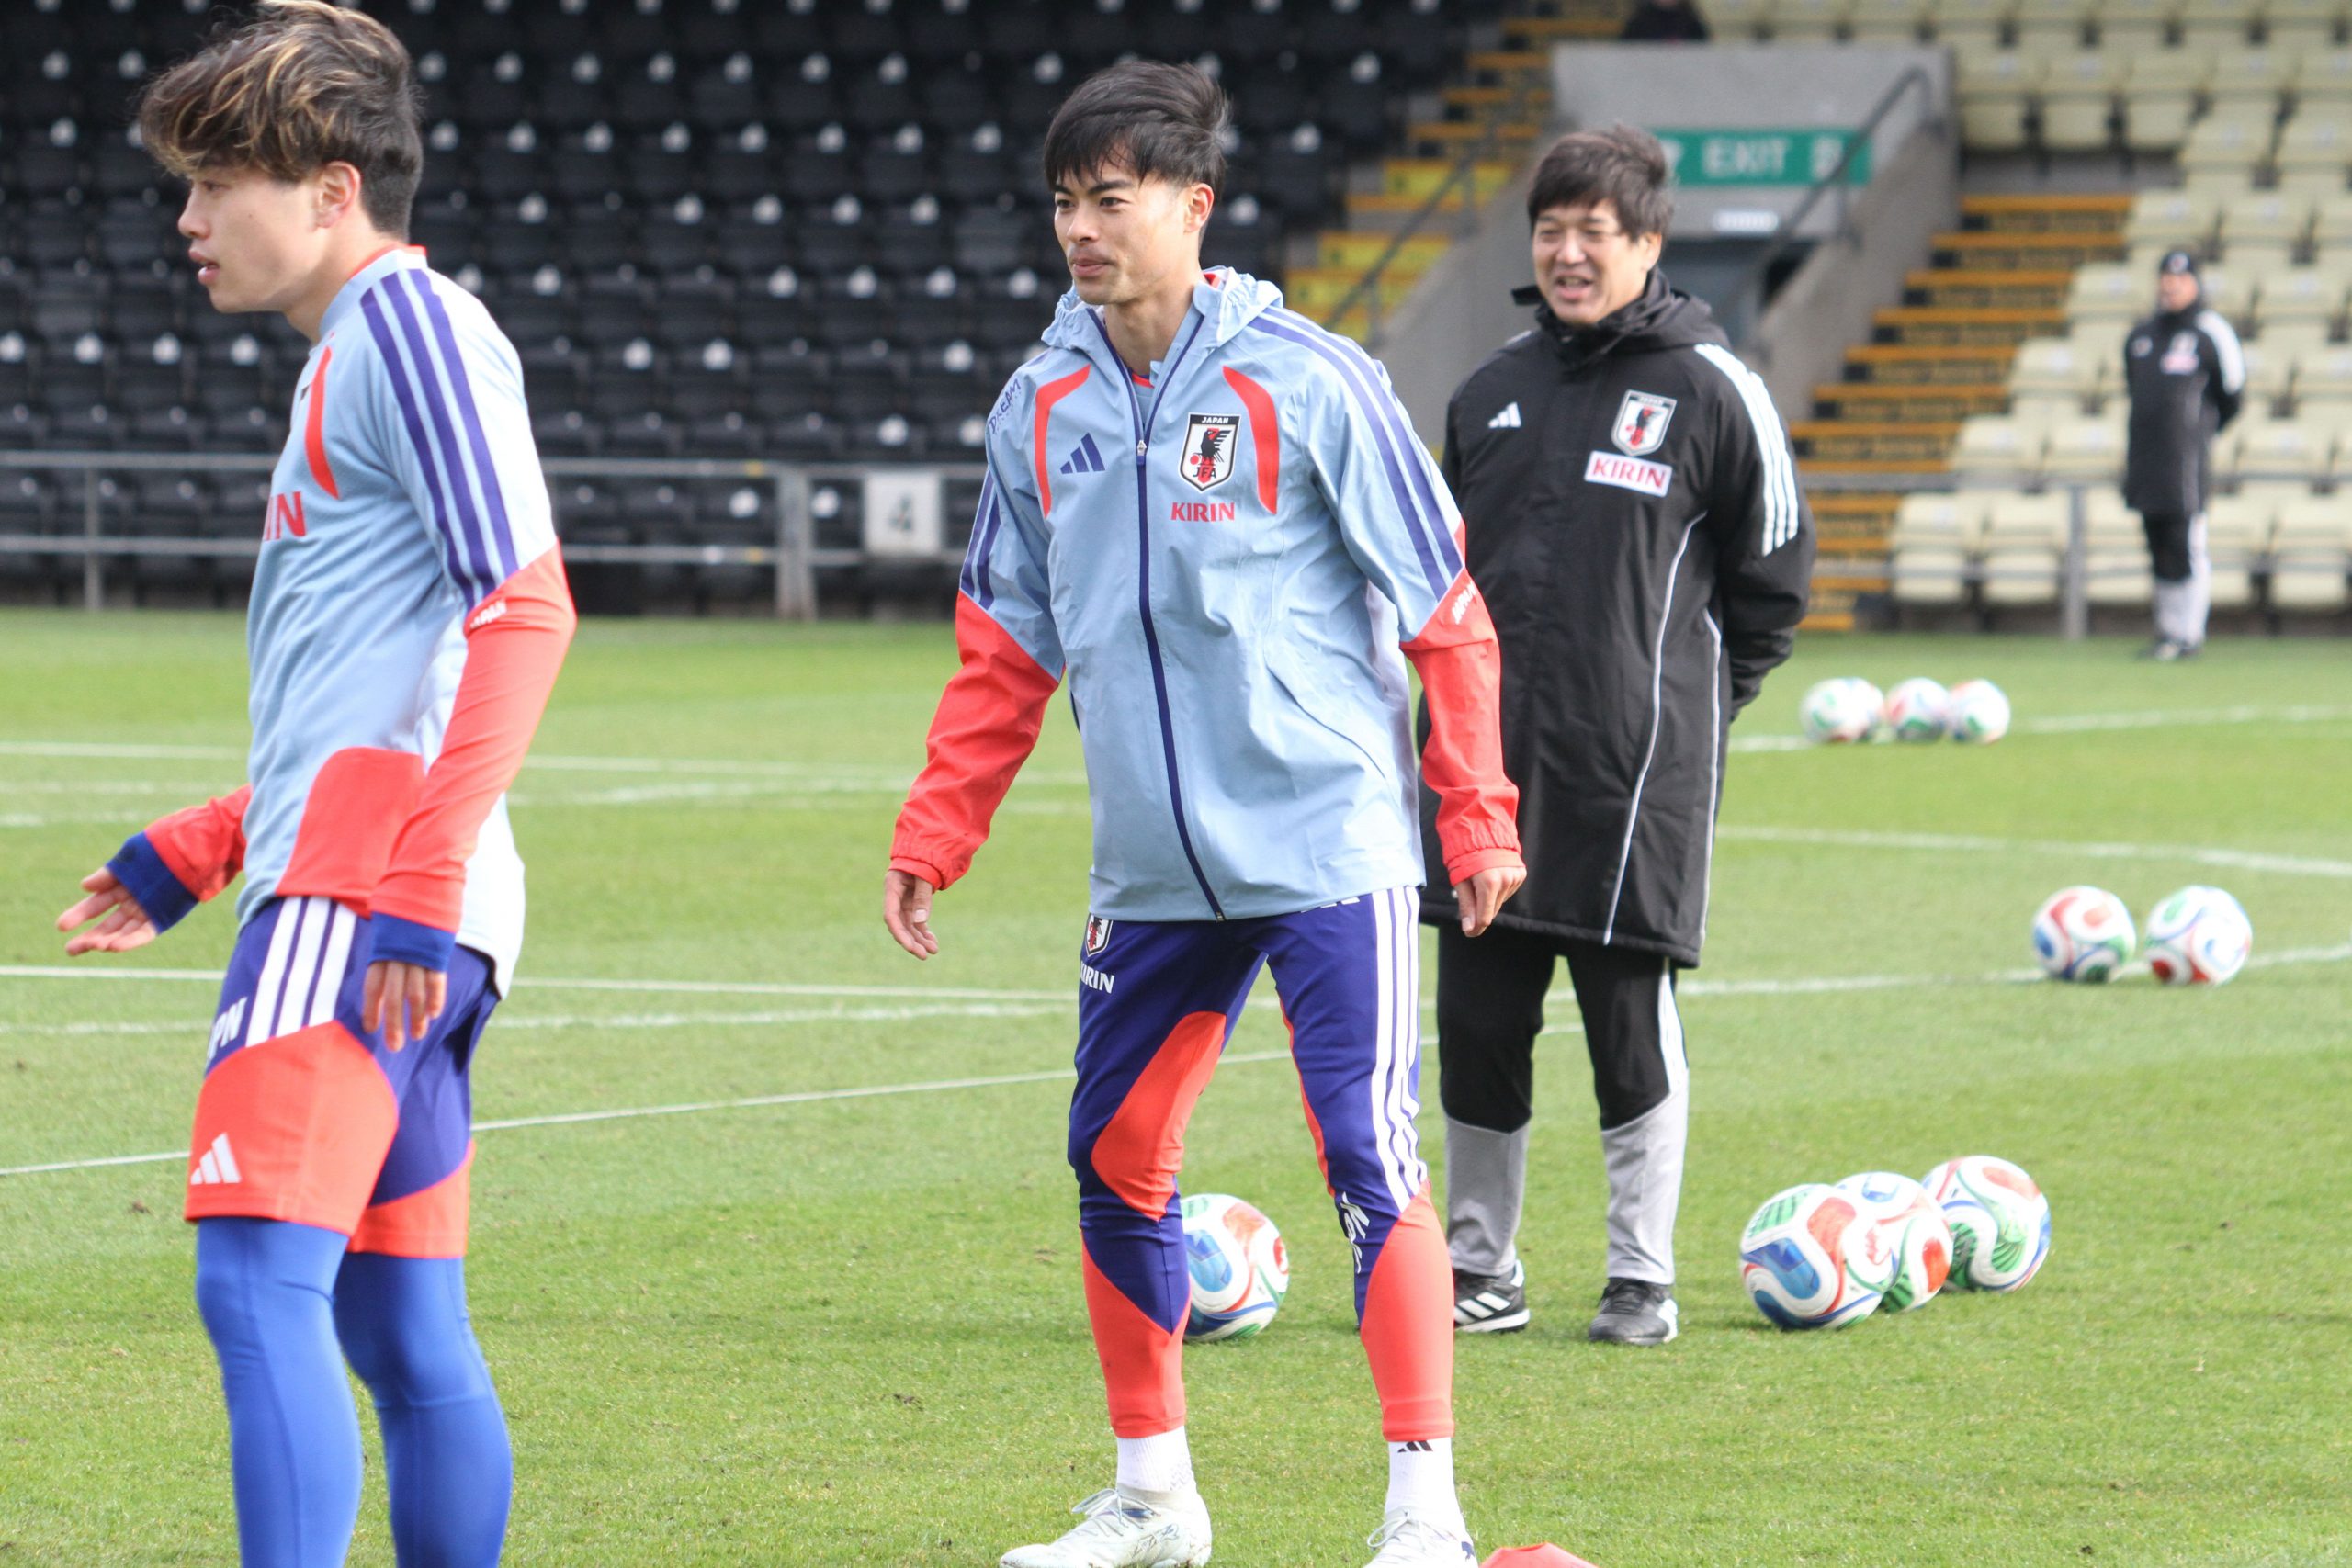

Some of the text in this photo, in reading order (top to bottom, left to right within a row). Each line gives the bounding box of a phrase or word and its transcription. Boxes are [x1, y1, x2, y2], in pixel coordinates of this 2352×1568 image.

[1702, 137, 1790, 178] EXIT
[1201, 416, 1229, 424] JAPAN
[1193, 466, 1217, 479] JFA
[1592, 458, 1667, 489] KIRIN
[888, 493, 913, 534] 4
[1170, 501, 1235, 522] KIRIN
